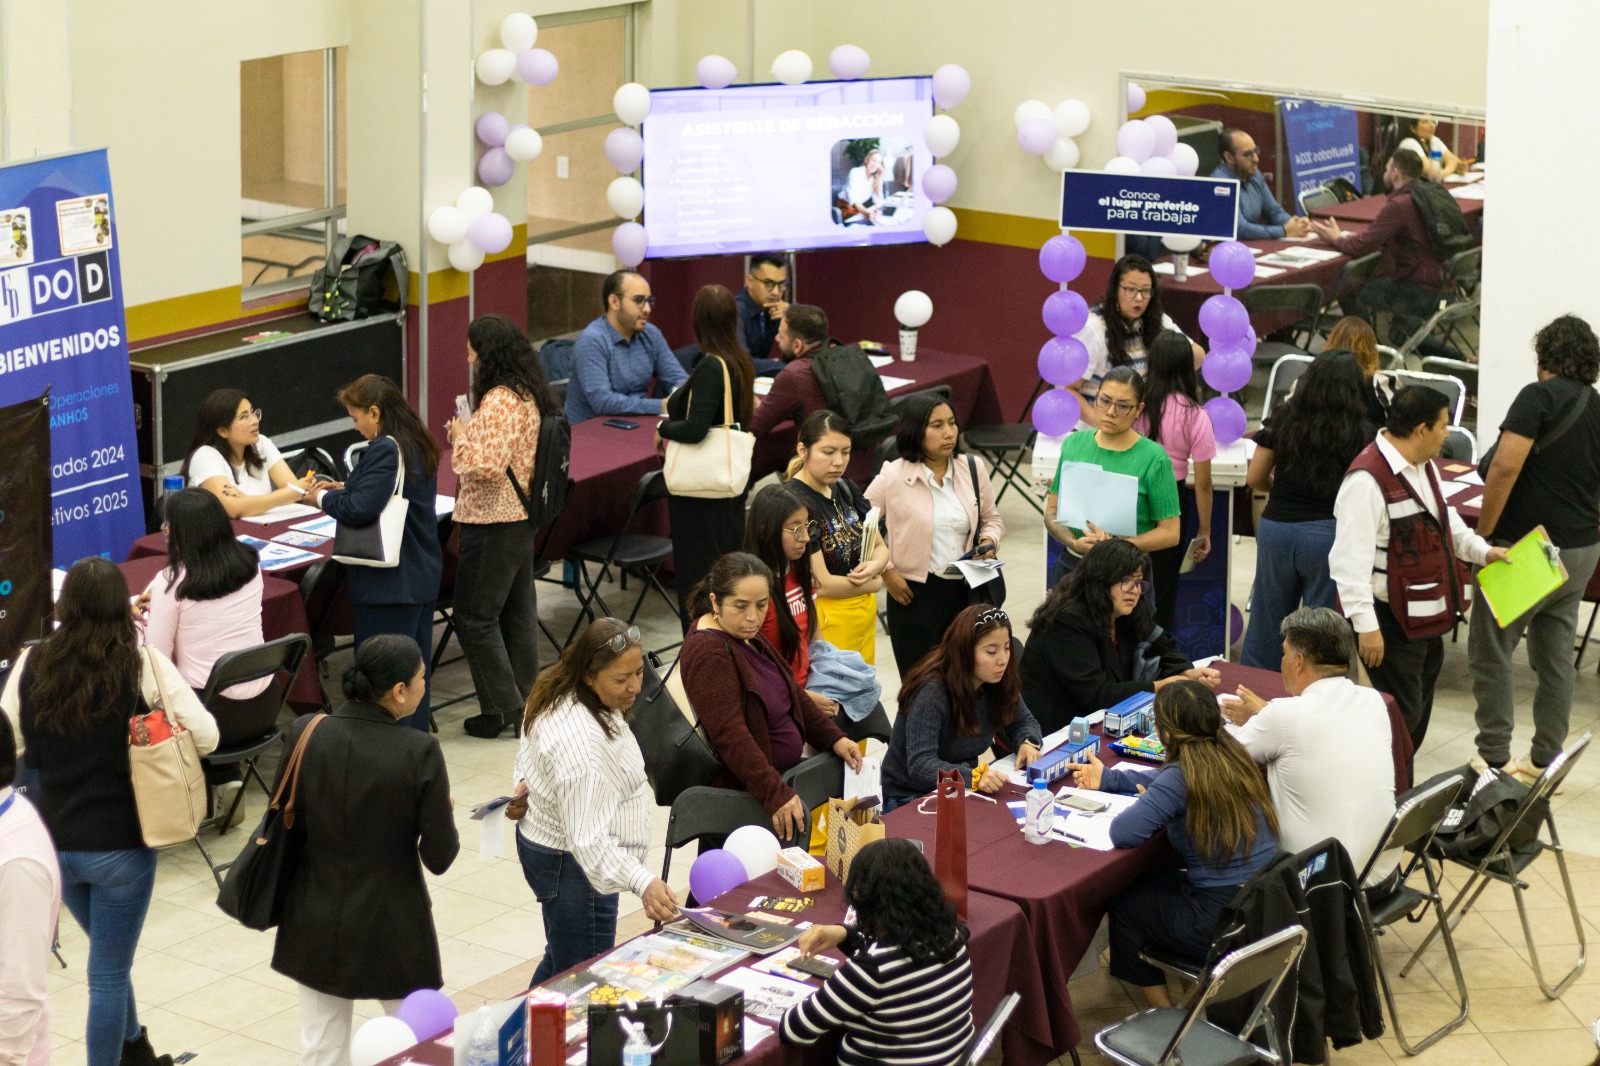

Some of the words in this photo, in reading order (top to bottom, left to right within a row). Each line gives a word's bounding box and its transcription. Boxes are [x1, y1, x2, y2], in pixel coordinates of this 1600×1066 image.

[681, 119, 774, 138] ASISTENTE
[779, 117, 801, 133] DE
[805, 110, 904, 131] REDACCIÓN
[1098, 196, 1110, 206] el
[1112, 197, 1143, 209] lugar
[1144, 200, 1200, 213] preferido
[1119, 188, 1161, 201] Conoce
[1107, 208, 1139, 220] para
[1141, 209, 1198, 226] trabajar
[49, 383, 119, 411] Operaciones
[51, 456, 88, 479] ados
[91, 443, 125, 469] 2024
[92, 489, 128, 515] 2025
